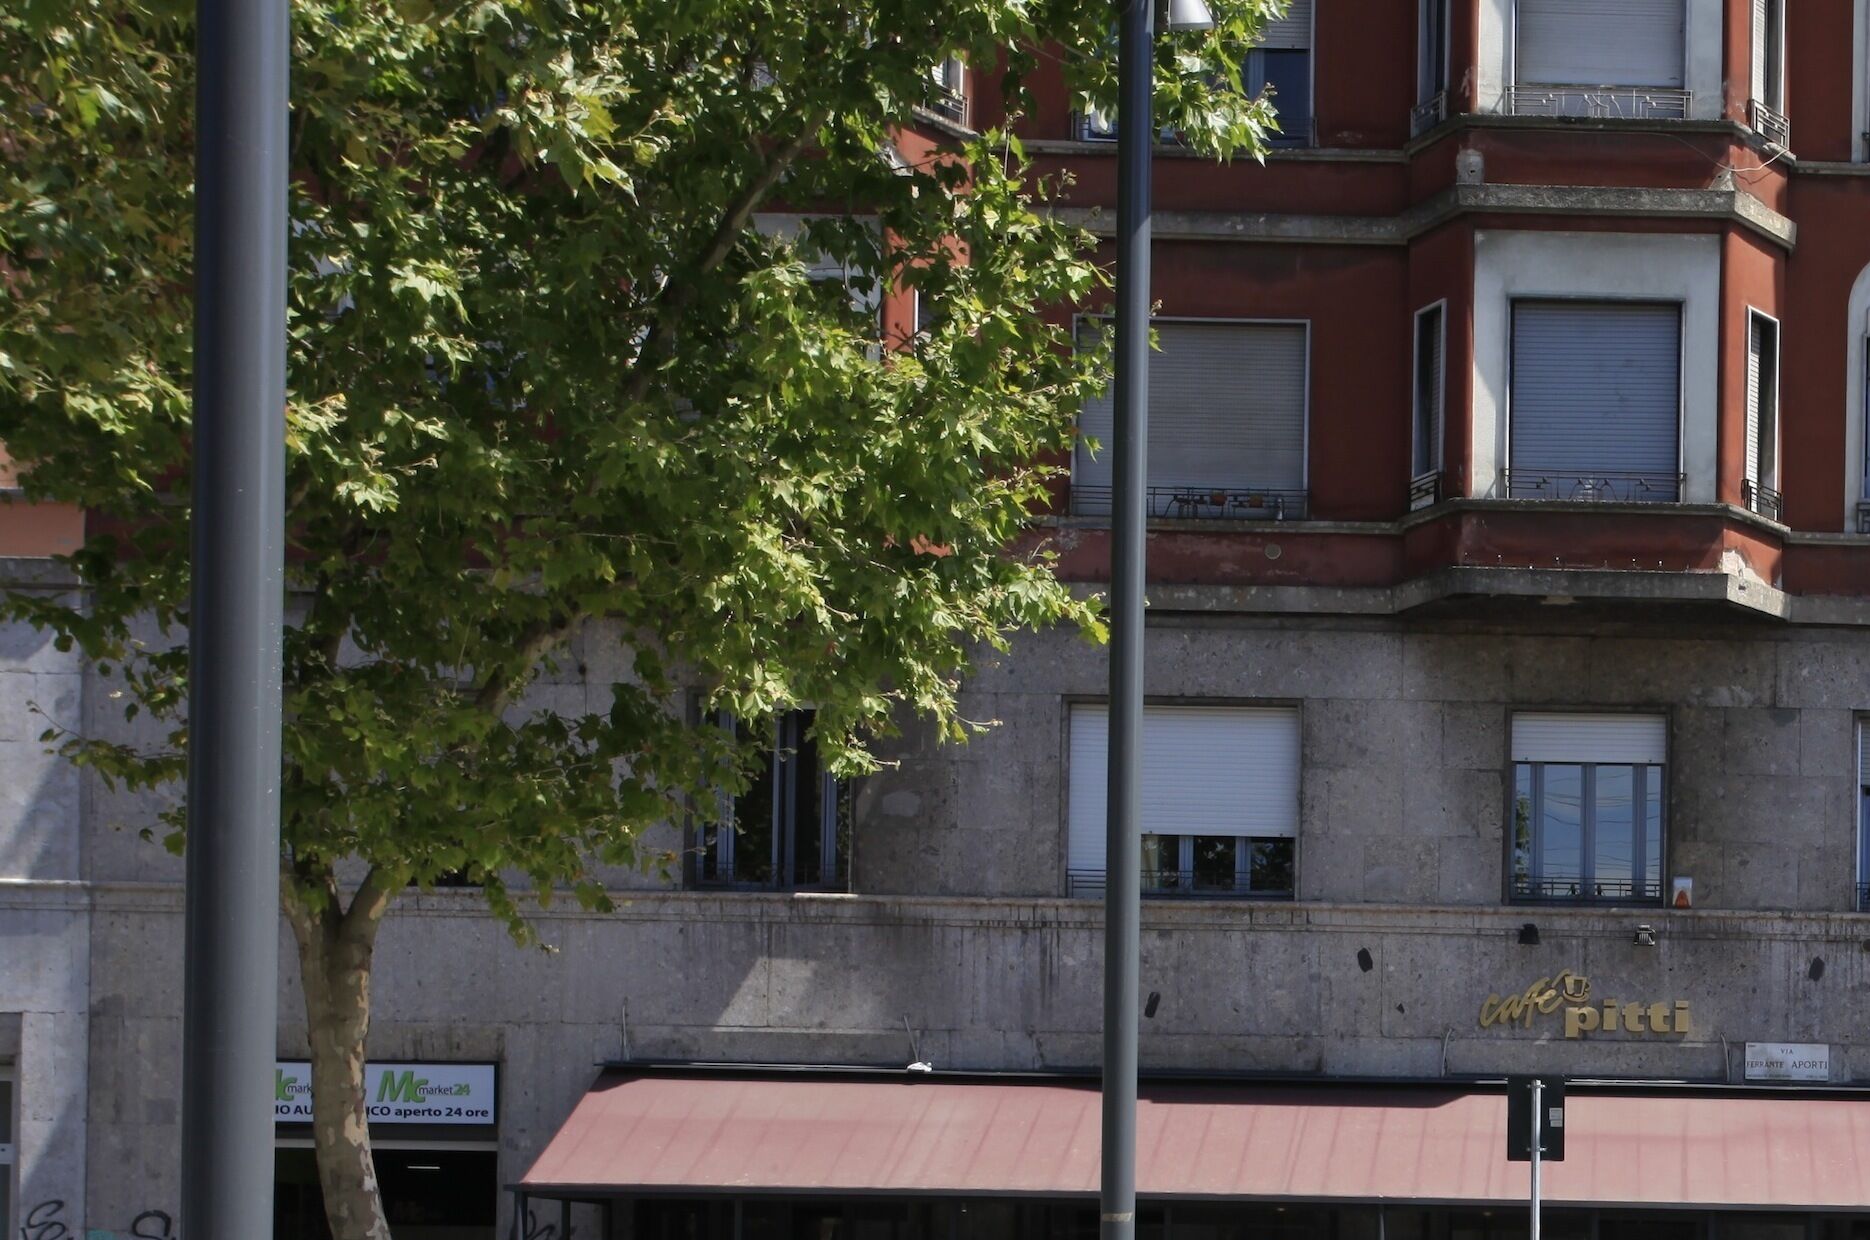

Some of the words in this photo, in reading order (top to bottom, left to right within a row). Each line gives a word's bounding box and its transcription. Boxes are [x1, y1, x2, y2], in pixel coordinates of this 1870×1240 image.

[1565, 999, 1689, 1038] pitti
[1746, 1061, 1784, 1069] FERRANTE
[1791, 1061, 1828, 1069] APORTI
[376, 1071, 429, 1103] Mc
[395, 1108, 442, 1120] aperto
[445, 1107, 462, 1117] 24
[465, 1109, 489, 1118] ore
